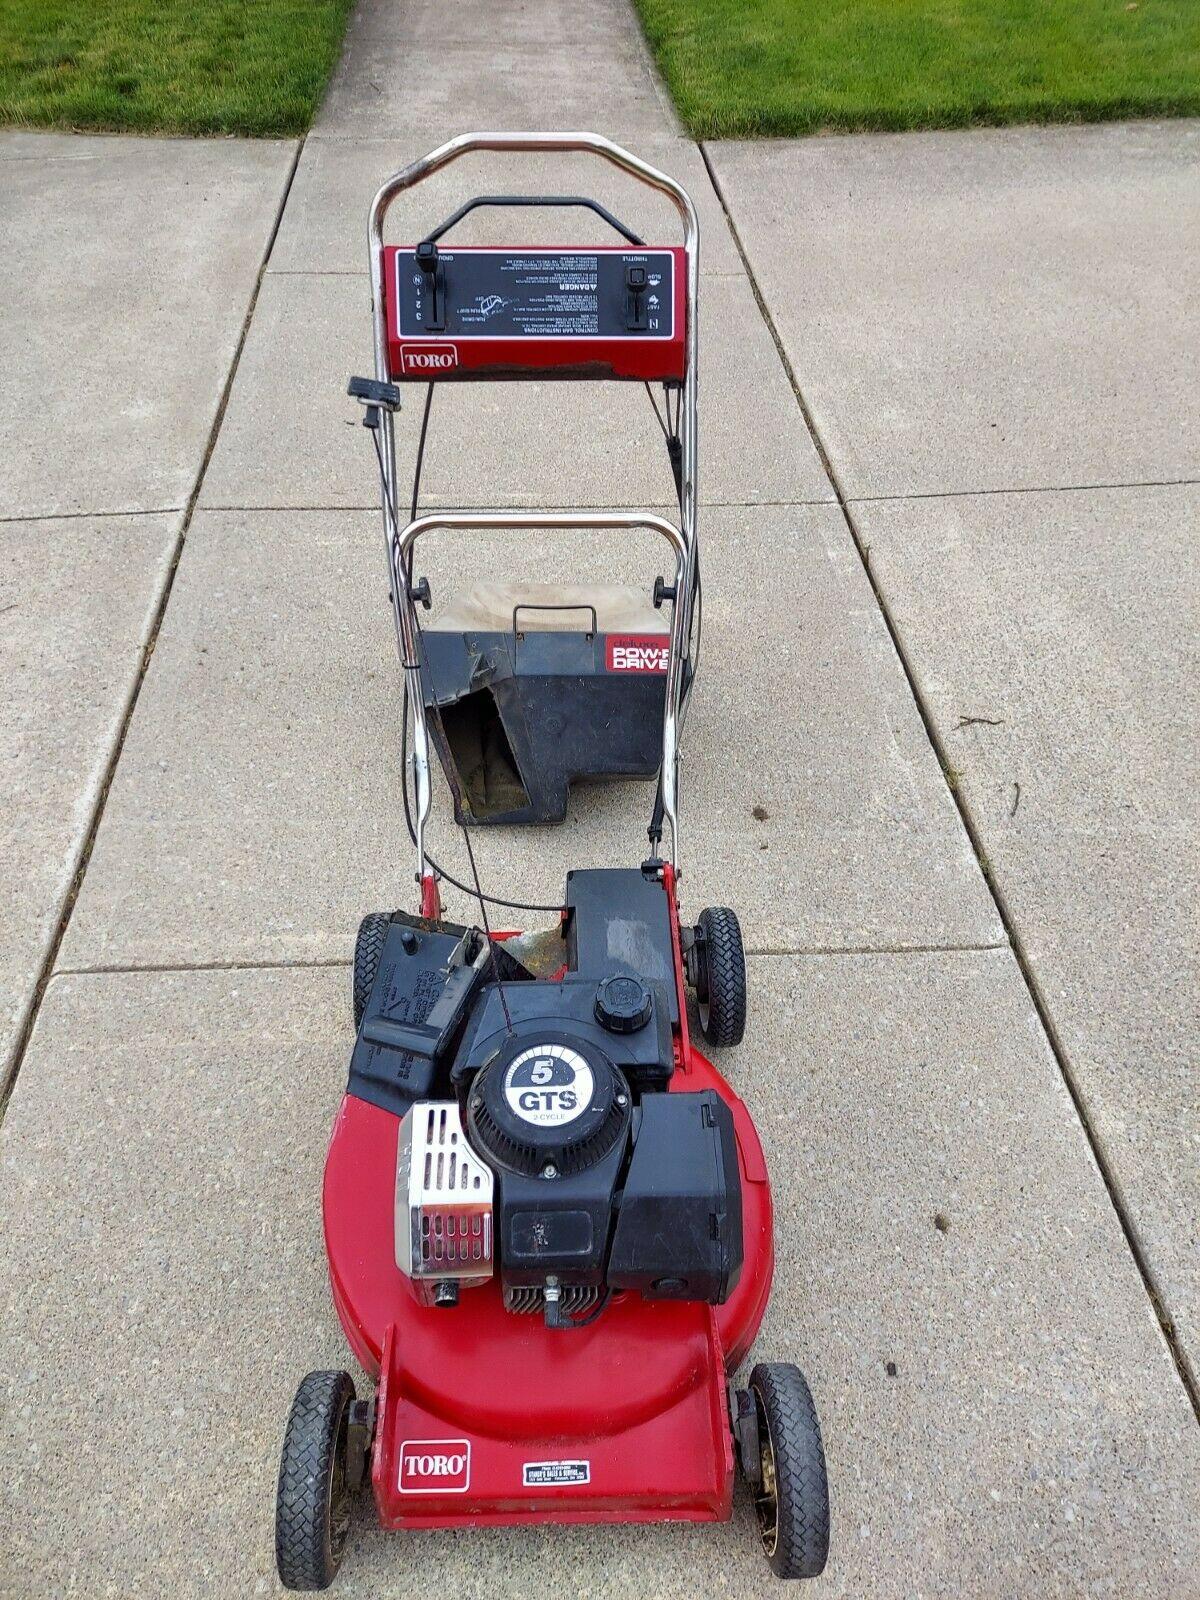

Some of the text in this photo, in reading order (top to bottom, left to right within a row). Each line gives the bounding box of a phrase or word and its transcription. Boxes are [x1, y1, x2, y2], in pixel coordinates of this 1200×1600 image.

[416, 288, 421, 296] 1
[416, 300, 422, 308] 2
[416, 312, 422, 320] 3
[405, 354, 453, 368] TORO
[613, 658, 668, 670] DRIVE
[530, 1058, 554, 1084] 5
[518, 1090, 578, 1111] GTS
[404, 1454, 464, 1476] TORO
